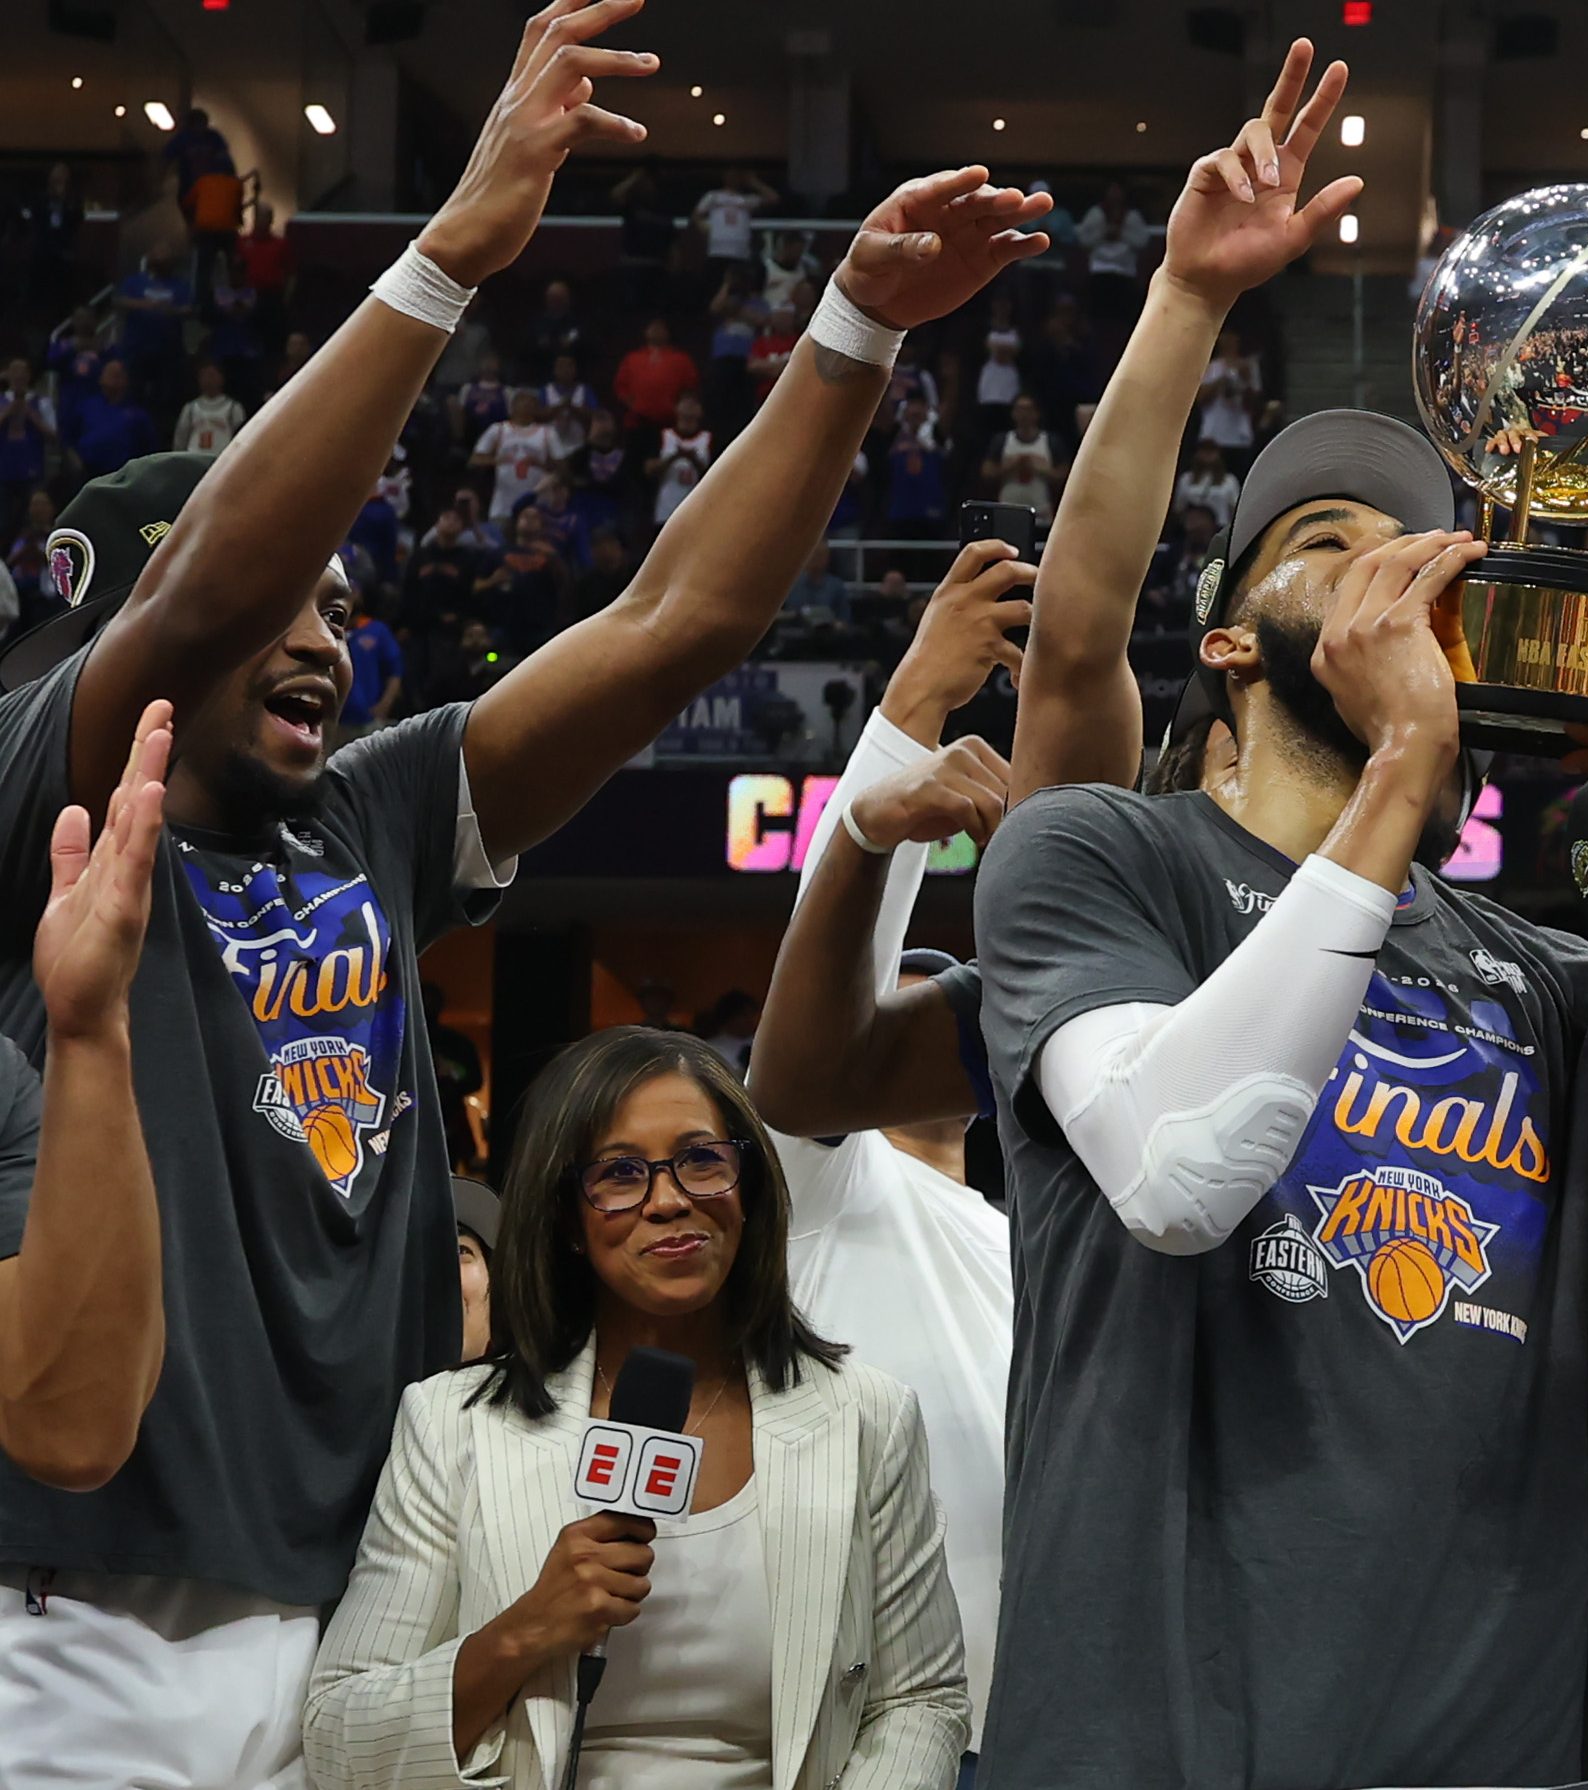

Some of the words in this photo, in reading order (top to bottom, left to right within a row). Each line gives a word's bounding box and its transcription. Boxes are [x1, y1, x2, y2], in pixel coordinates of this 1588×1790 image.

[1517, 638, 1551, 665] NBA
[283, 1045, 308, 1063] NEW
[309, 1040, 347, 1058] YORK
[1359, 1005, 1449, 1032] ONFERENCE
[1454, 1025, 1536, 1056] CHAMPIONS
[274, 1049, 380, 1107] NICKS
[1330, 1030, 1551, 1184] inals
[1377, 1169, 1404, 1187] NEW
[1408, 1172, 1441, 1199] YORK
[1318, 1179, 1486, 1274] KNICKS
[1255, 1239, 1324, 1287] EASTERN
[1454, 1300, 1482, 1326] NEW
[1482, 1306, 1511, 1334] YORK
